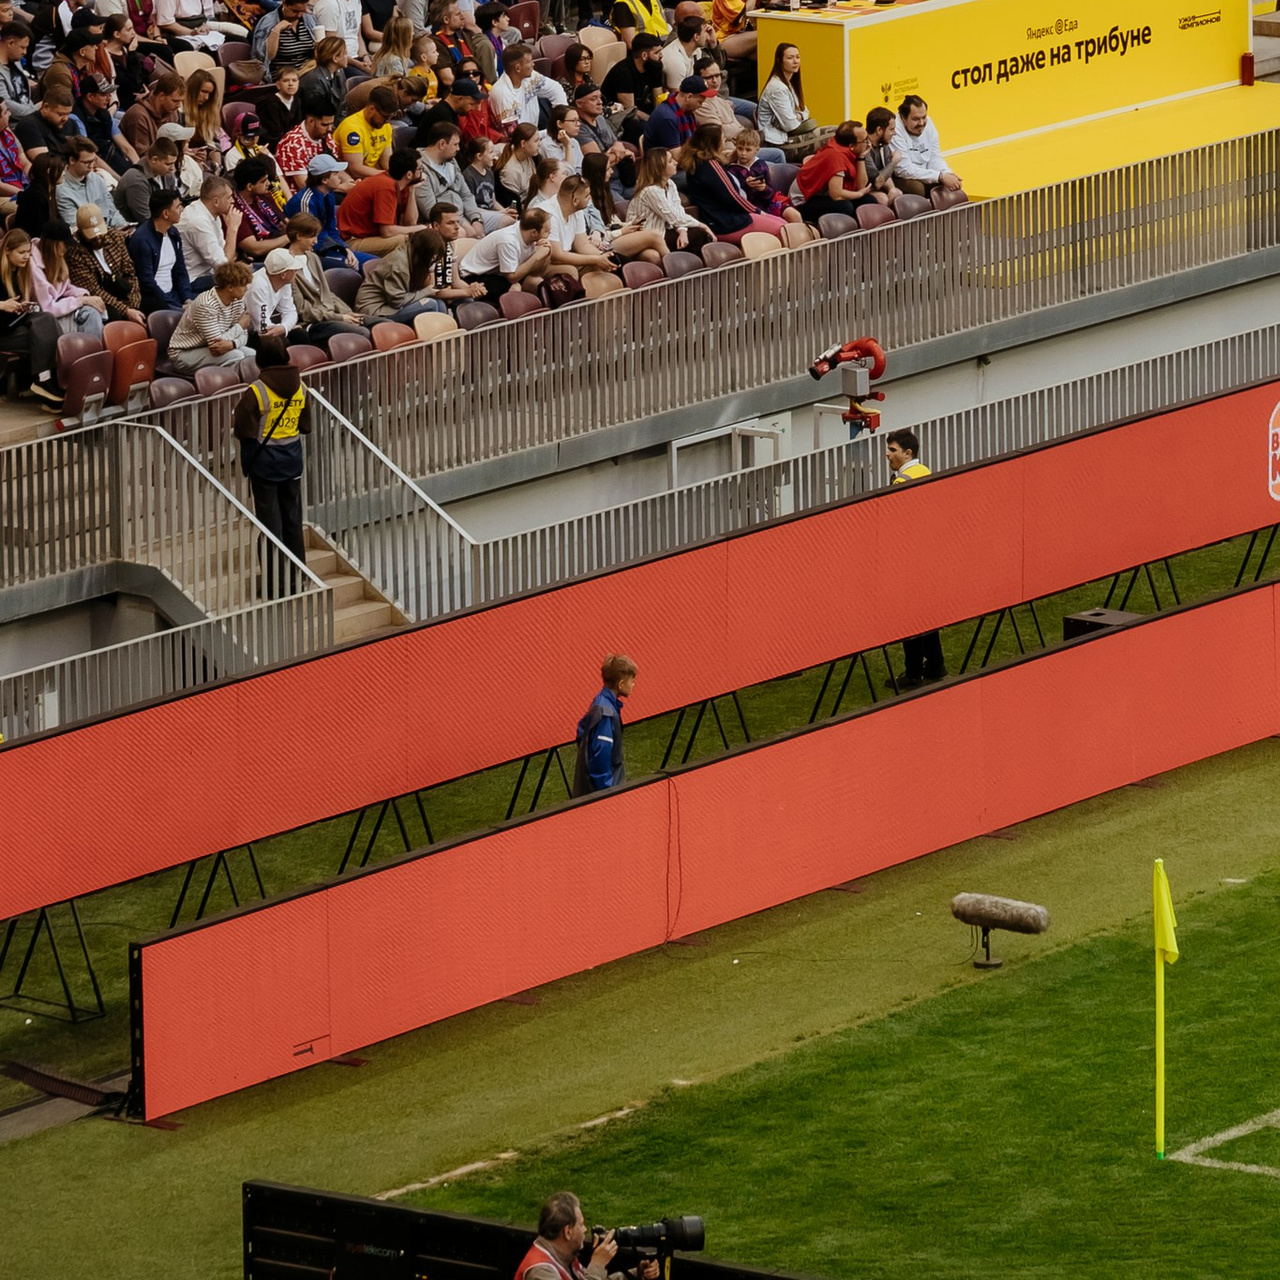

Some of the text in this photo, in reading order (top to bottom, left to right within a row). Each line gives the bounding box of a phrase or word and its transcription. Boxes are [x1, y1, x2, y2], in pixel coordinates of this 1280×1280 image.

[1026, 18, 1078, 40] Яндекс Еда
[951, 24, 1152, 90] стол даже на трибуне
